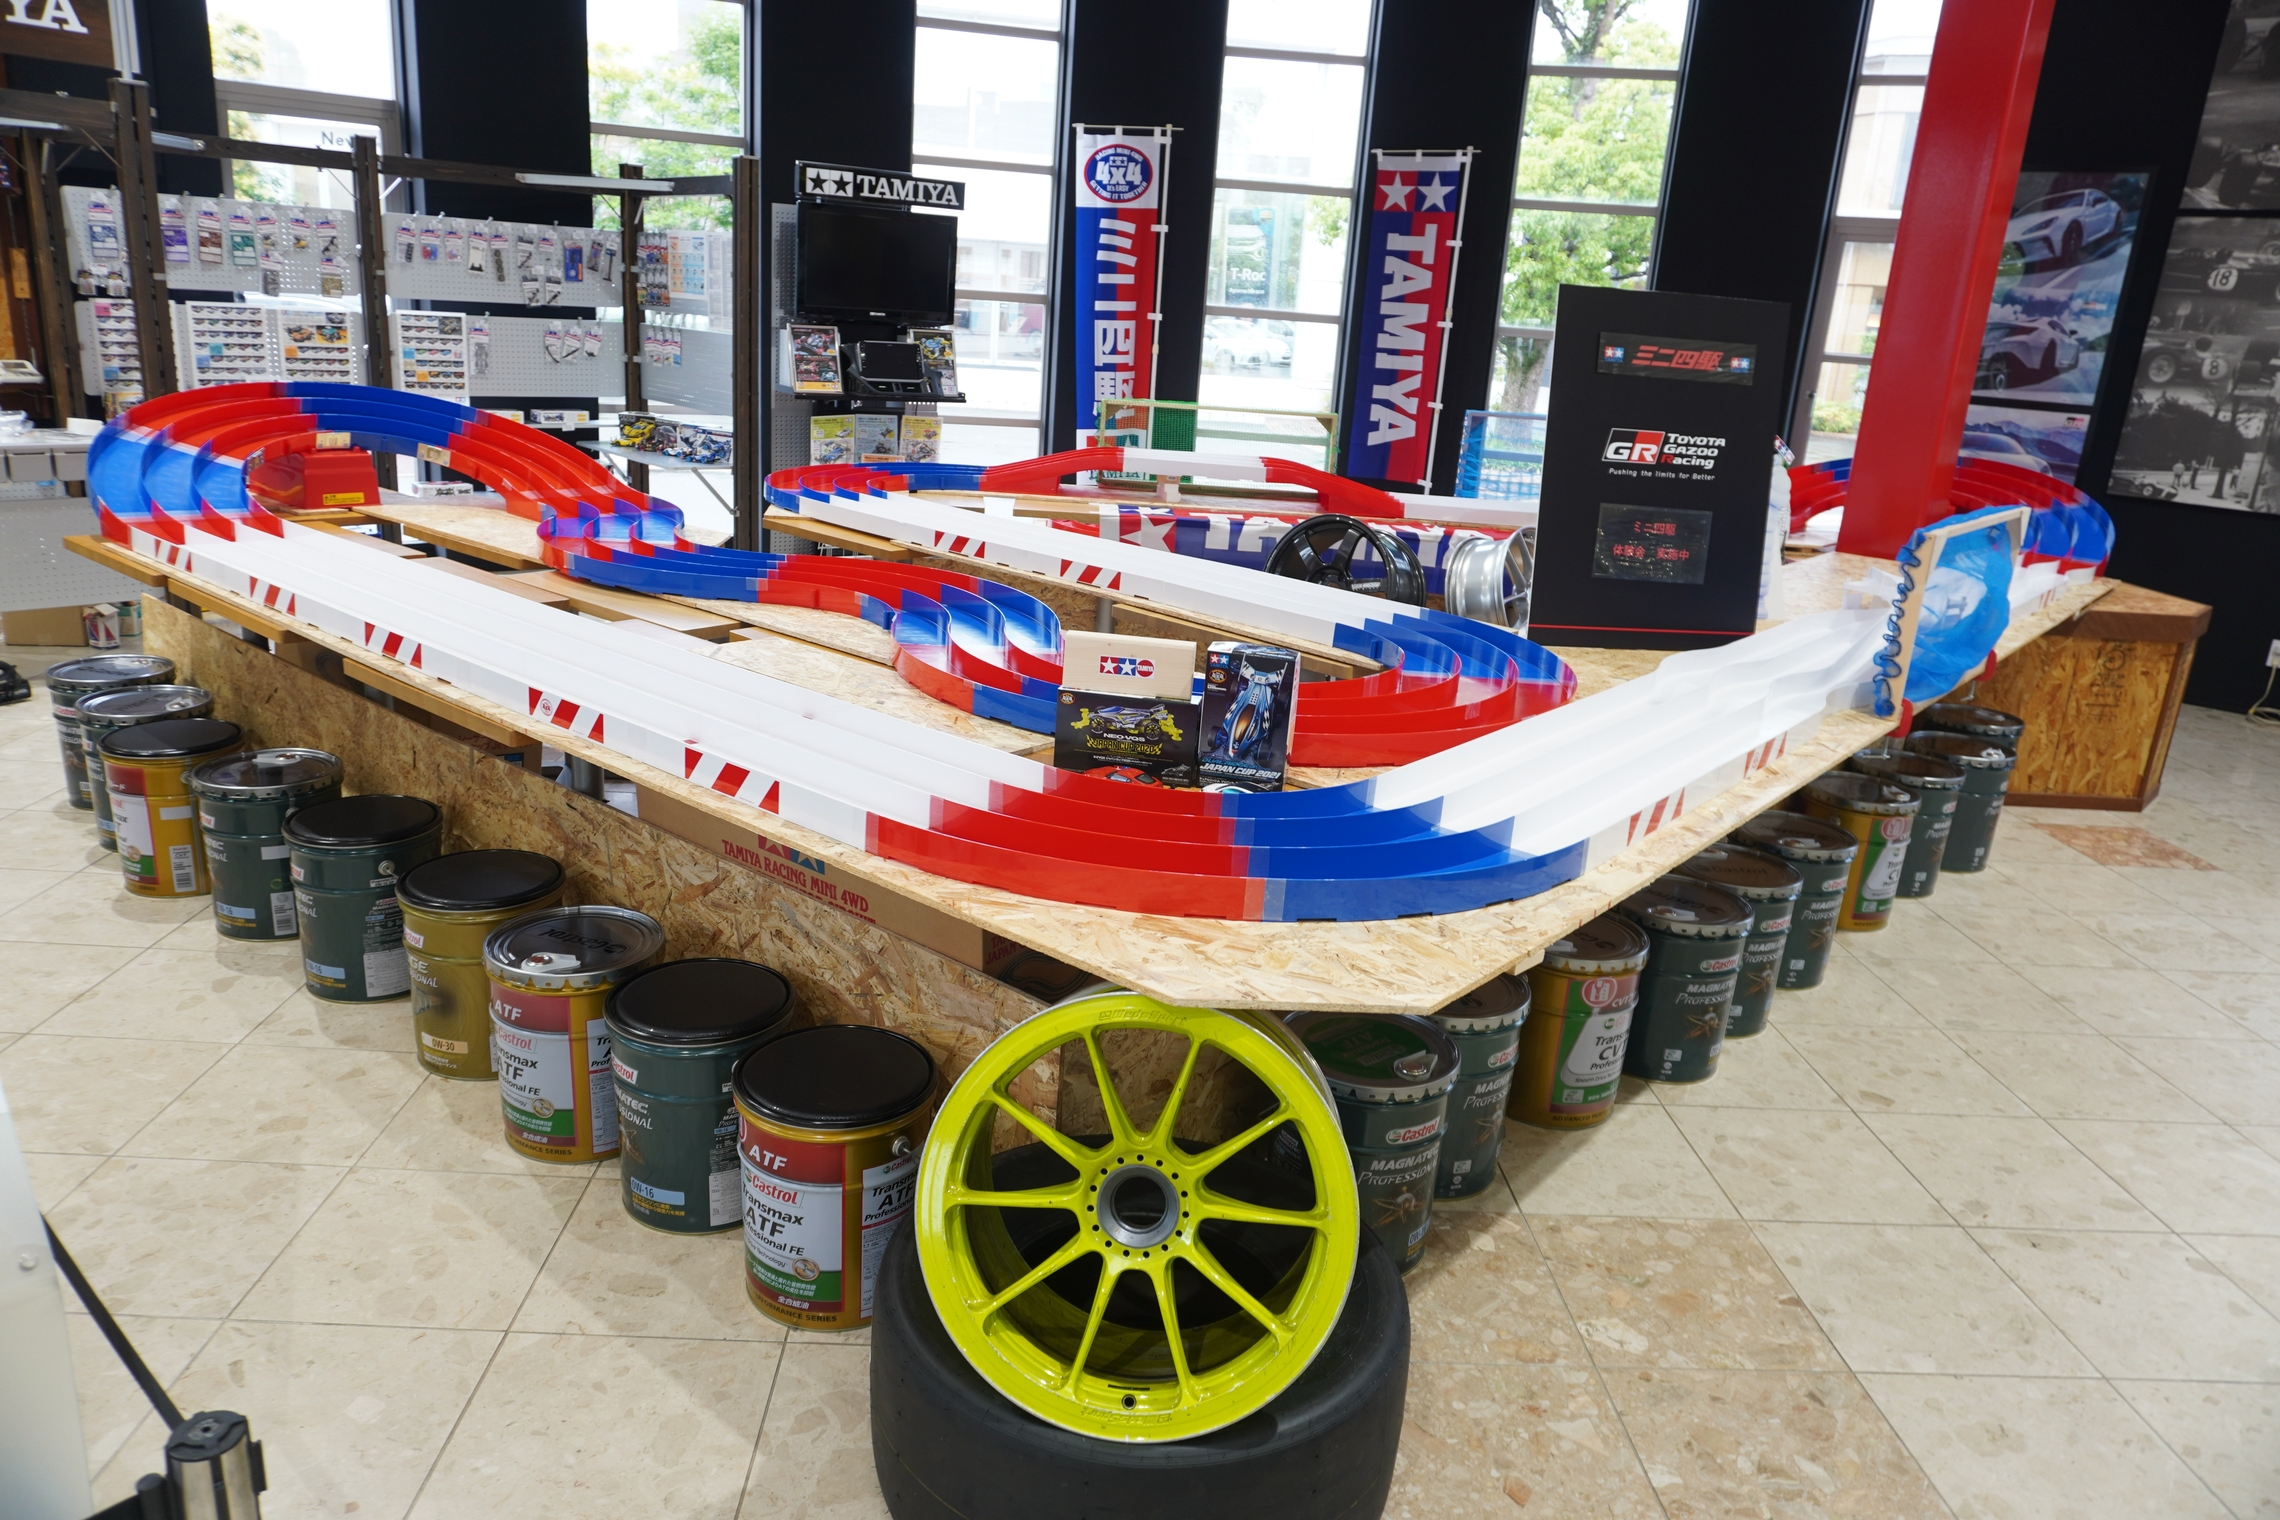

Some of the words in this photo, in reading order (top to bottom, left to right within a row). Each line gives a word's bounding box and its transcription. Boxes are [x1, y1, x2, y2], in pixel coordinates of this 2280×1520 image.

[321, 131, 356, 149] Ne
[857, 174, 960, 206] TAMIYA
[1089, 179, 1112, 199] GETTING
[1119, 180, 1148, 200] TOGETHER
[1230, 267, 1267, 281] T-Roc
[2213, 270, 2233, 287] 18
[1093, 218, 1137, 417] ミニ四駆
[1367, 223, 1438, 446] TAMIYA
[1631, 345, 1724, 371] ミニ四駆
[2209, 360, 2219, 375] 8
[1666, 433, 1726, 447] TOYOTA
[1606, 441, 1659, 461] GR
[1663, 444, 1719, 457] GAZOO
[1660, 454, 1715, 469] Racing
[1609, 467, 1638, 477] Pushing
[1692, 473, 1716, 481] Better
[1634, 521, 1677, 535] ミニ四駆
[1612, 543, 1645, 558] 体験会
[1656, 547, 1689, 561] 実施中
[1137, 664, 1154, 672] TAMIYA
[1095, 738, 1119, 750] JAPAN
[1119, 741, 1135, 751] CUP
[1135, 743, 1155, 754] 2020
[1103, 732, 1146, 742] NEO-VQS
[1199, 762, 1235, 773] JAPAN
[1234, 766, 1257, 775] CUP
[1256, 770, 1282, 779] 2021
[722, 839, 762, 869] TAMIYA
[764, 856, 807, 888] RACING
[810, 875, 838, 900] MINI
[841, 889, 869, 913] 4WD
[539, 928, 601, 949] Castrol
[985, 942, 1017, 966] JAPAN
[408, 955, 430, 974] GE
[494, 1000, 523, 1021] ATF
[431, 1037, 455, 1052] 0W-30
[1595, 1029, 1630, 1047] Trans
[500, 1048, 539, 1070] nsmax
[528, 1086, 541, 1096] FE
[1475, 1072, 1513, 1095] MAGNA
[614, 1084, 649, 1115] NATEC
[521, 1131, 549, 1145] 全合成油
[1402, 1119, 1438, 1142] Castrol
[545, 1147, 573, 1155] SERIES
[748, 1144, 789, 1171] ATF
[890, 1155, 914, 1172] Castrol
[631, 1178, 655, 1199] 0W-16
[752, 1173, 798, 1206] Castrol
[742, 1183, 805, 1226] Transmax
[745, 1206, 787, 1238] ATF
[789, 1246, 806, 1257] FE
[777, 1295, 810, 1310] 全合成油
[805, 1313, 838, 1323] SERIES
